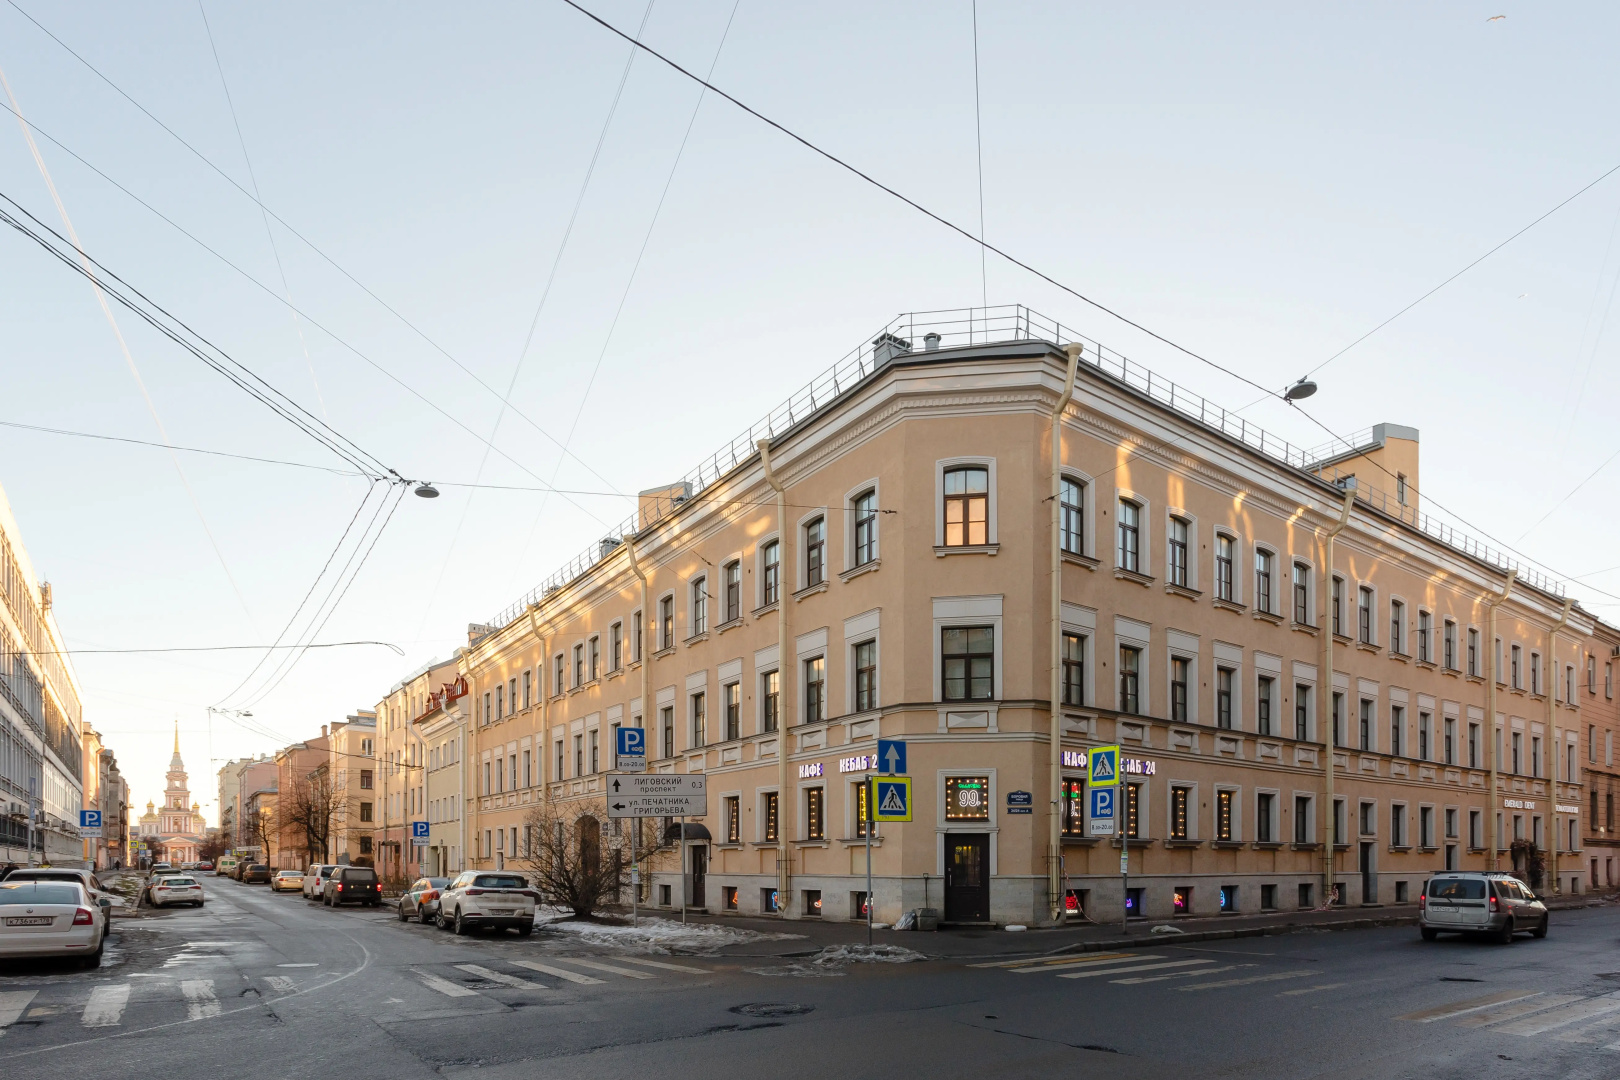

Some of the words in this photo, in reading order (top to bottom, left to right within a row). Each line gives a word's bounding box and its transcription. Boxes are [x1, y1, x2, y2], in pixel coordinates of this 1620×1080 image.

[625, 731, 640, 752] P
[799, 763, 823, 778] КАФЕ
[840, 756, 869, 773] КЕБАБ
[871, 754, 878, 769] 2
[1064, 751, 1087, 767] КАФ
[1145, 760, 1156, 775] 24
[634, 776, 682, 785] ЛИГОВСКИЙ
[641, 798, 690, 806] ПЕЧАТНИКА
[1097, 792, 1110, 815] P
[85, 811, 99, 826] P
[634, 807, 686, 815] ГРИГОРЬЕВА
[417, 823, 427, 836] P
